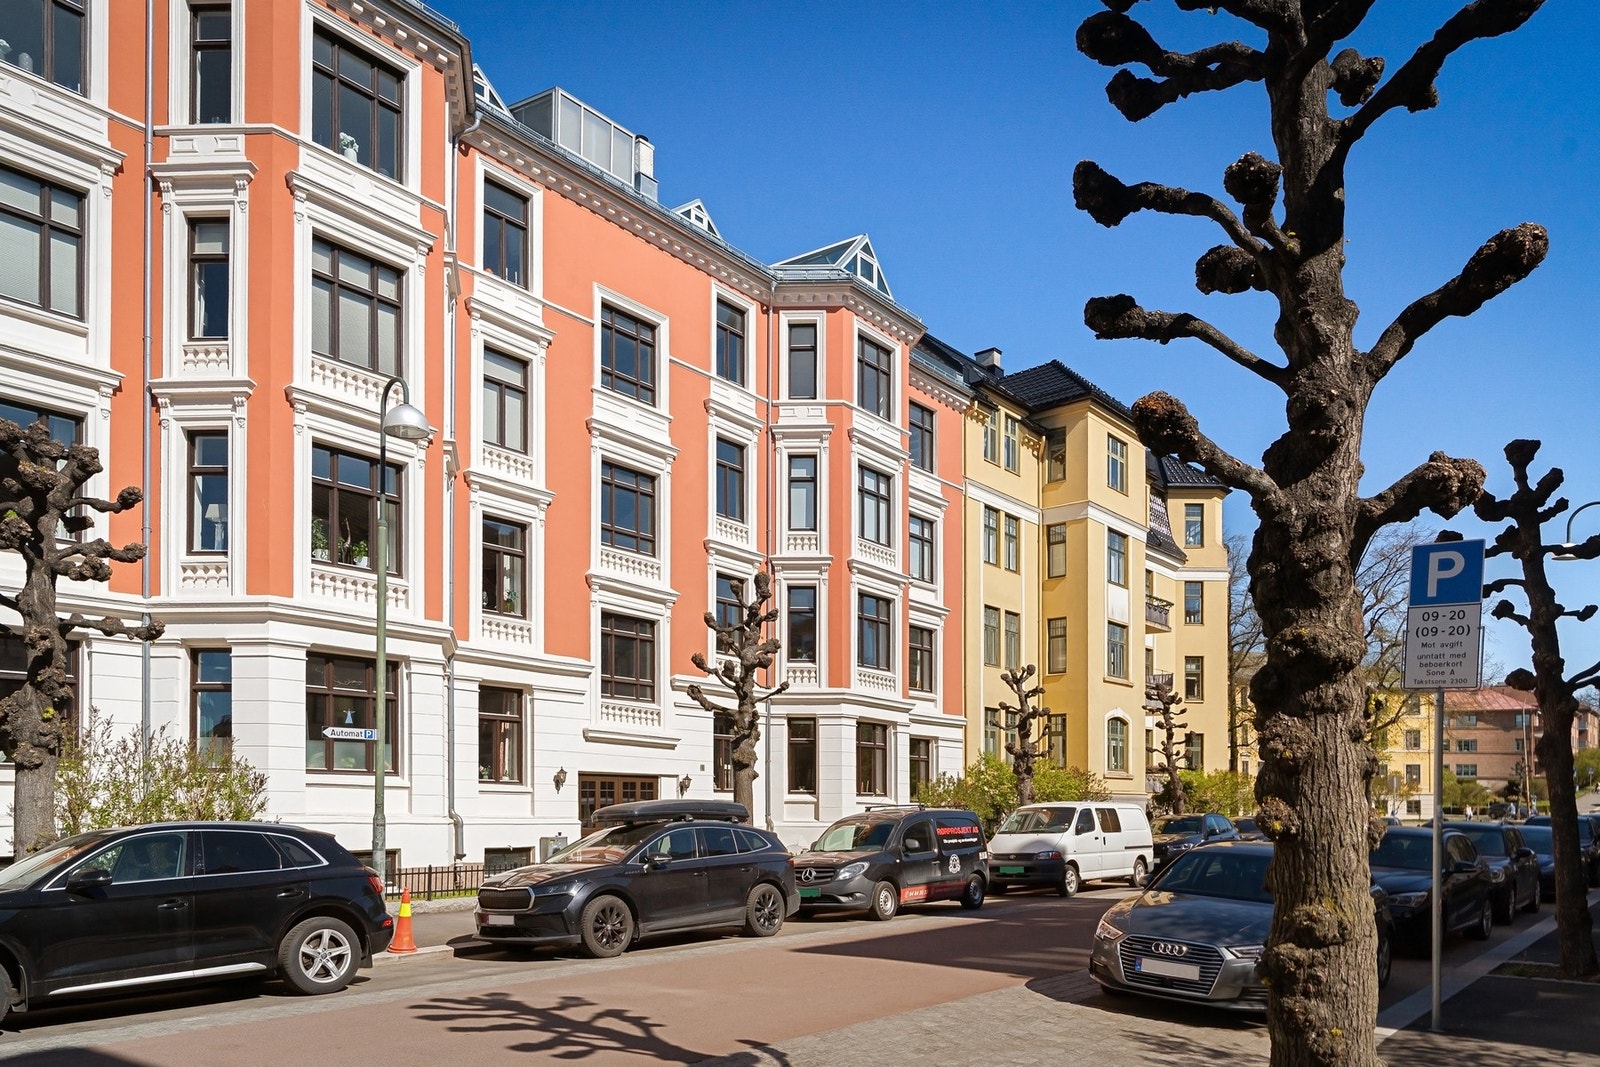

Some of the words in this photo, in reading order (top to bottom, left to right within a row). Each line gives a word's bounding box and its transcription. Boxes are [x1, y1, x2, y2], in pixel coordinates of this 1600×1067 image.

[1427, 550, 1465, 597] P
[1440, 641, 1463, 649] avgift
[330, 729, 363, 738] Automat
